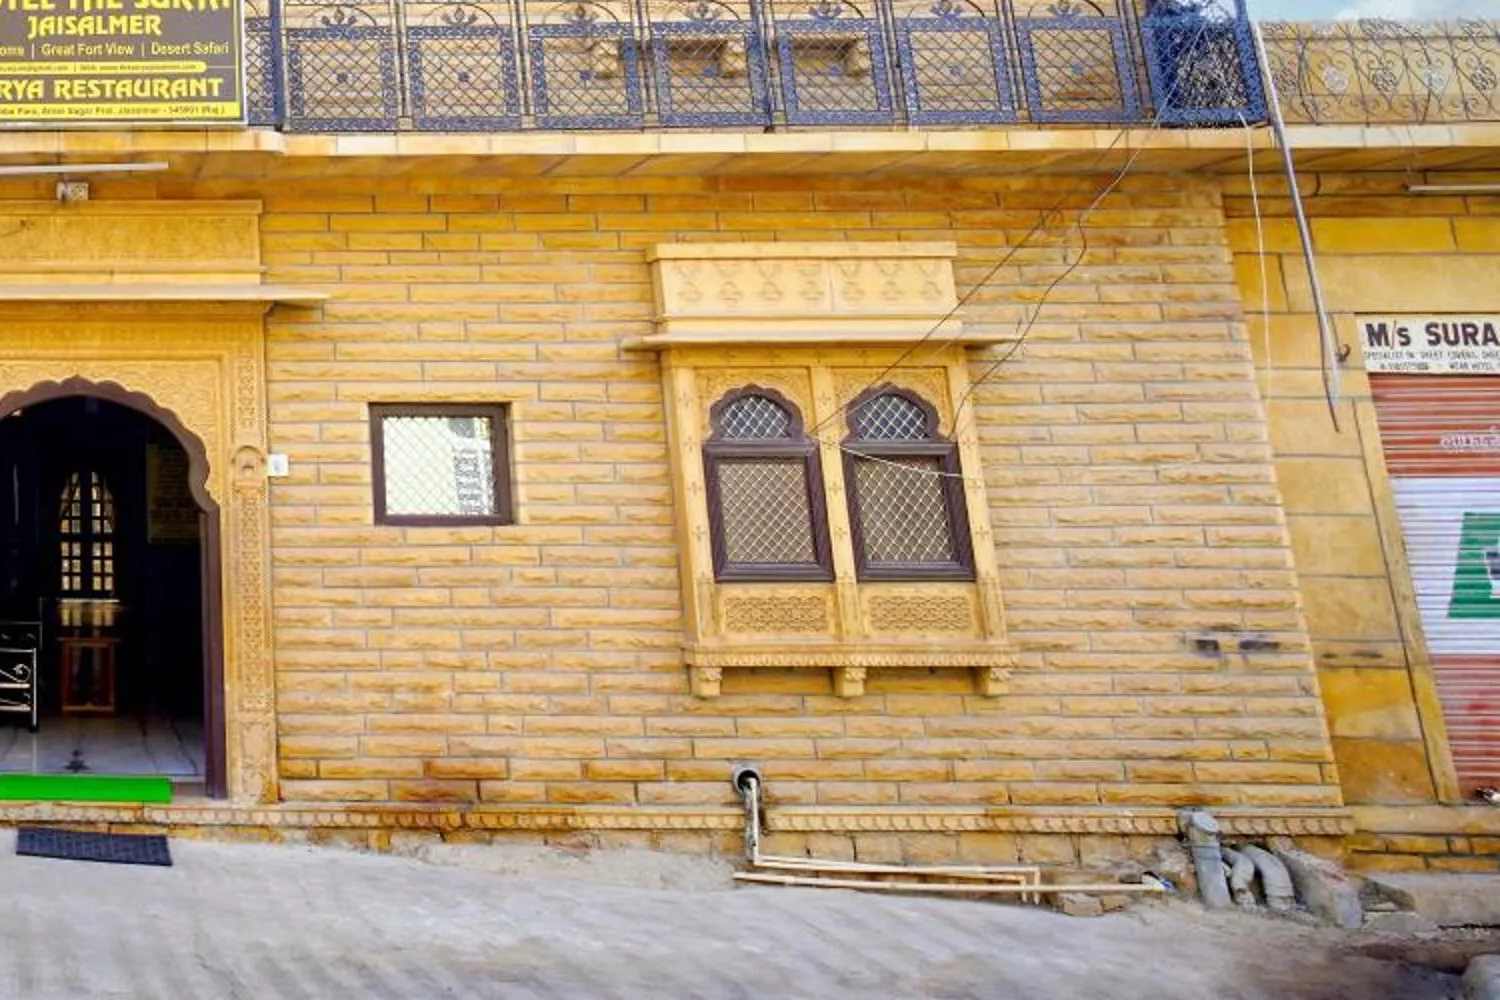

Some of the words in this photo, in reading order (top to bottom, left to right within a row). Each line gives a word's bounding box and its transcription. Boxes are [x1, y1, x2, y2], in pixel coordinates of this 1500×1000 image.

[27, 14, 162, 39] JAISALMER
[41, 43, 74, 56] Great
[77, 43, 102, 55] Fort
[105, 43, 134, 55] View
[151, 42, 191, 55] Desert
[193, 41, 229, 54] Safari
[53, 77, 224, 100] RESTAURANT
[1424, 321, 1500, 347] SURA
